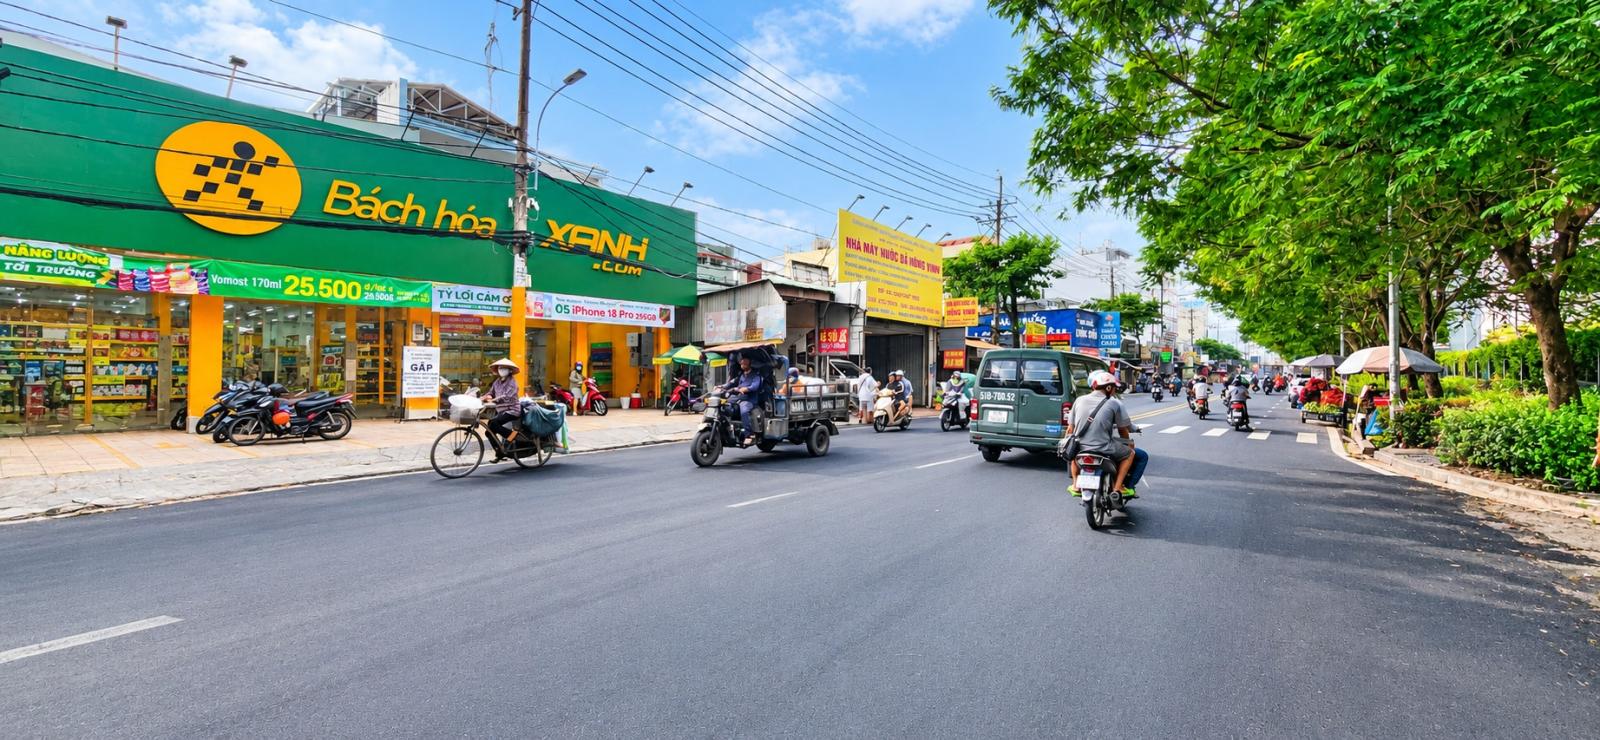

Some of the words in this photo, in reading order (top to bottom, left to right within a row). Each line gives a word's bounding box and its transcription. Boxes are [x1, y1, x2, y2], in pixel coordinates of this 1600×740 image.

[323, 179, 426, 227] Bách
[433, 199, 497, 238] hóa
[540, 219, 649, 261] XANH
[211, 274, 248, 287] Vomost
[252, 277, 282, 289] 170ml
[284, 274, 362, 300] 25.500
[572, 304, 606, 318] iPhone
[607, 308, 617, 318] 18
[619, 309, 634, 319] Pro
